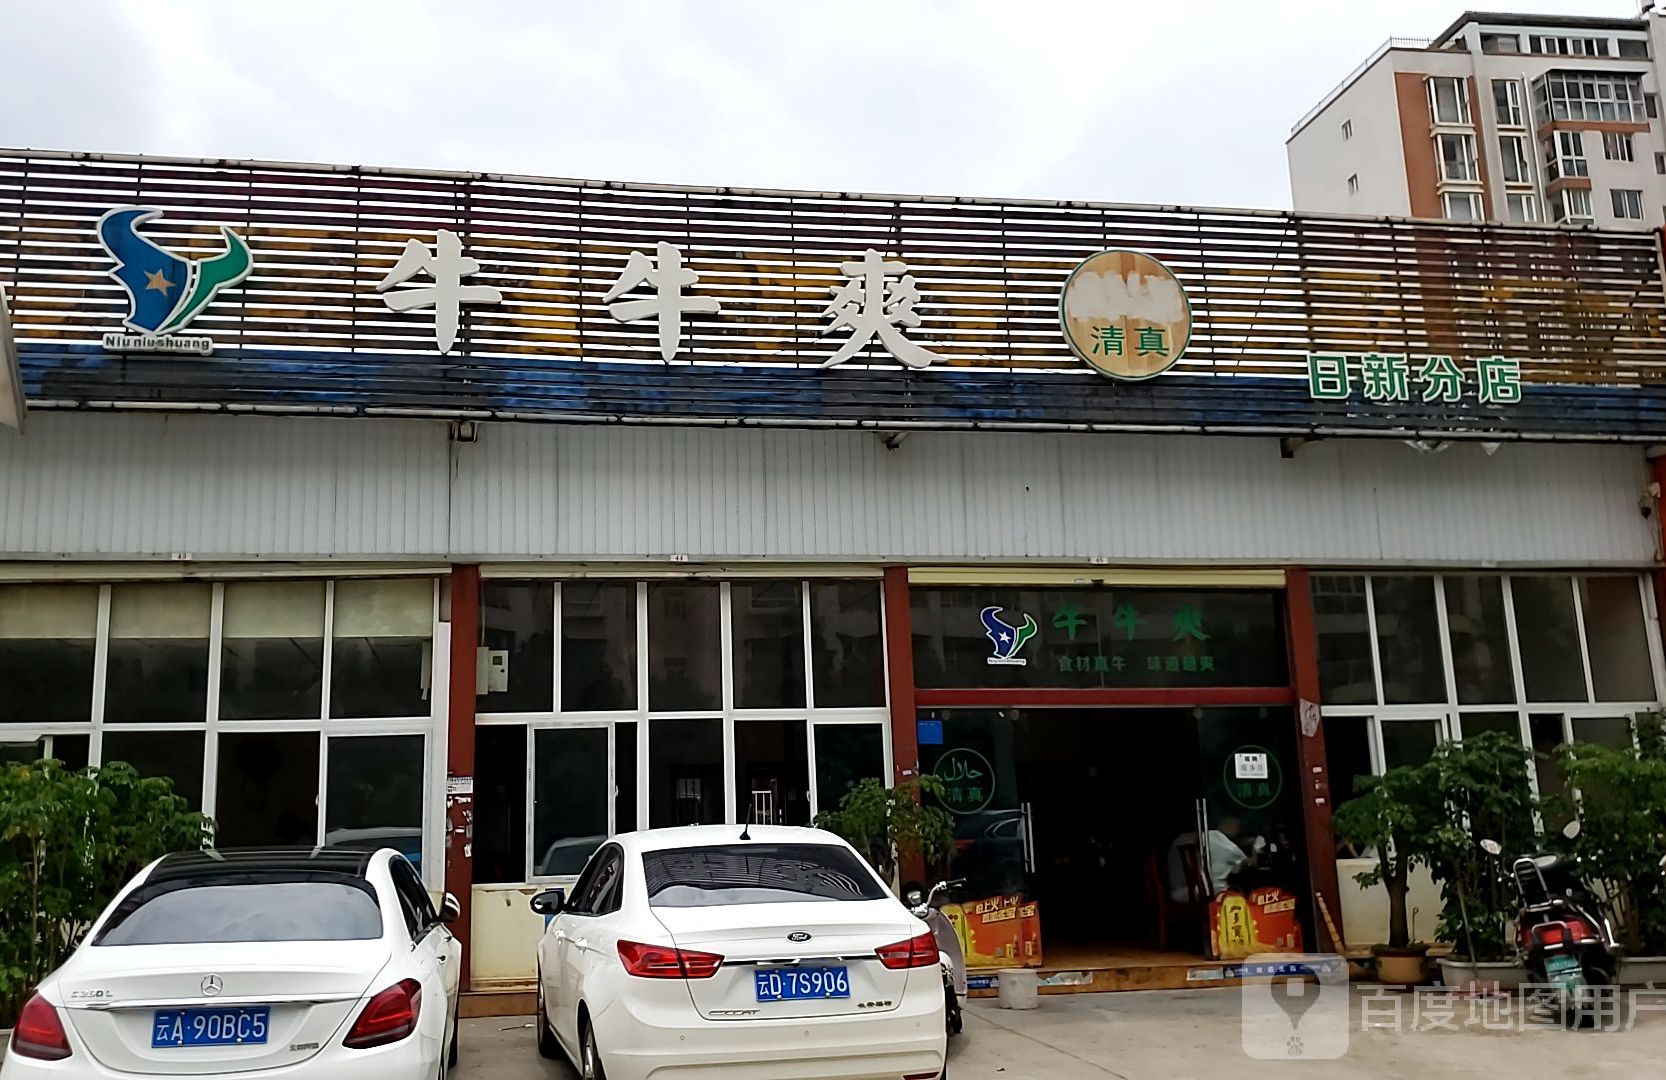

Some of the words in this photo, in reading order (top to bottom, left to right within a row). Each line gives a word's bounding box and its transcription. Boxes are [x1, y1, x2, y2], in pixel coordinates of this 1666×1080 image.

[376, 228, 949, 369] 牛牛爽
[1089, 324, 1170, 358] 清真
[1307, 351, 1522, 403] 日新分店
[1052, 601, 1212, 641] 牛牛爽
